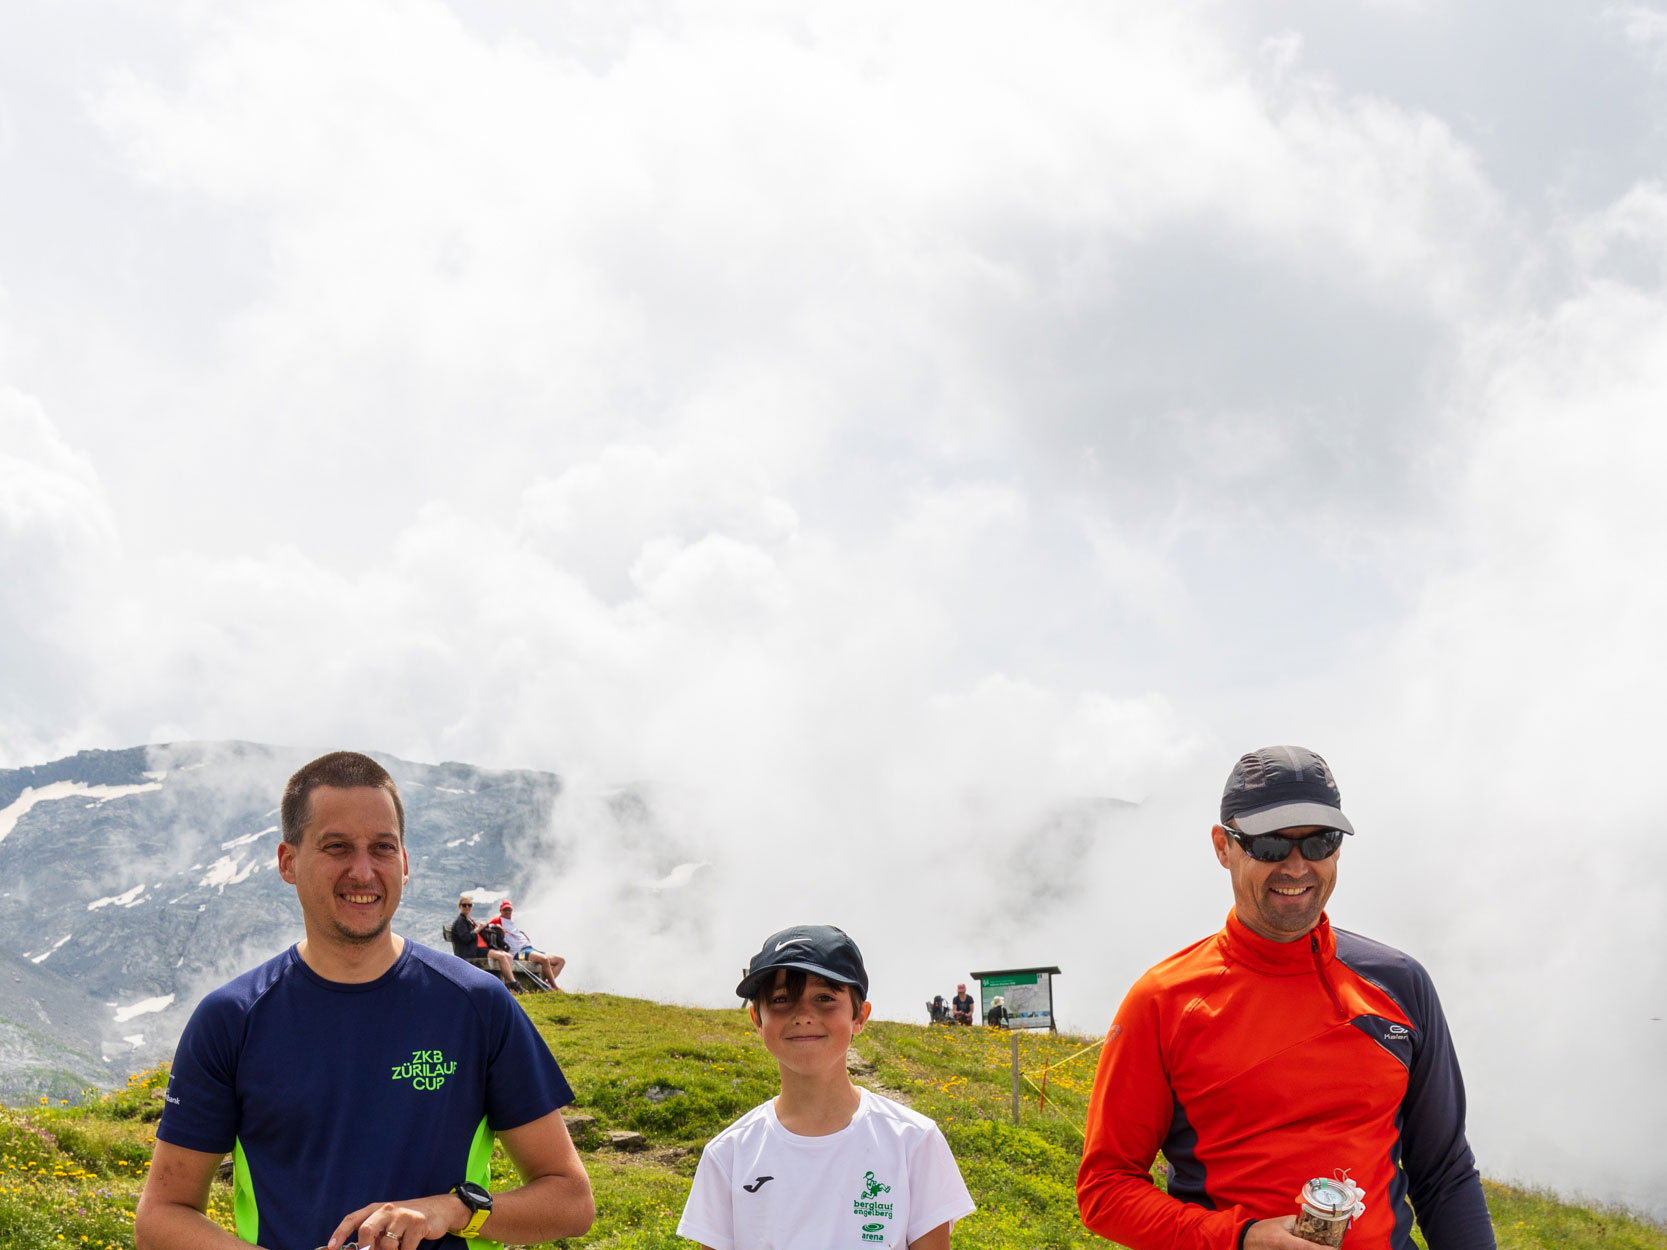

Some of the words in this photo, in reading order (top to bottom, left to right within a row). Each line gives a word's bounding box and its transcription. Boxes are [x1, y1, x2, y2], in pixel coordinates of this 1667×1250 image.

[412, 1050, 443, 1063] ZKB
[412, 1077, 445, 1091] CUP
[853, 1199, 894, 1211] berglauf
[853, 1208, 893, 1220] engelberg
[861, 1232, 884, 1241] arena
